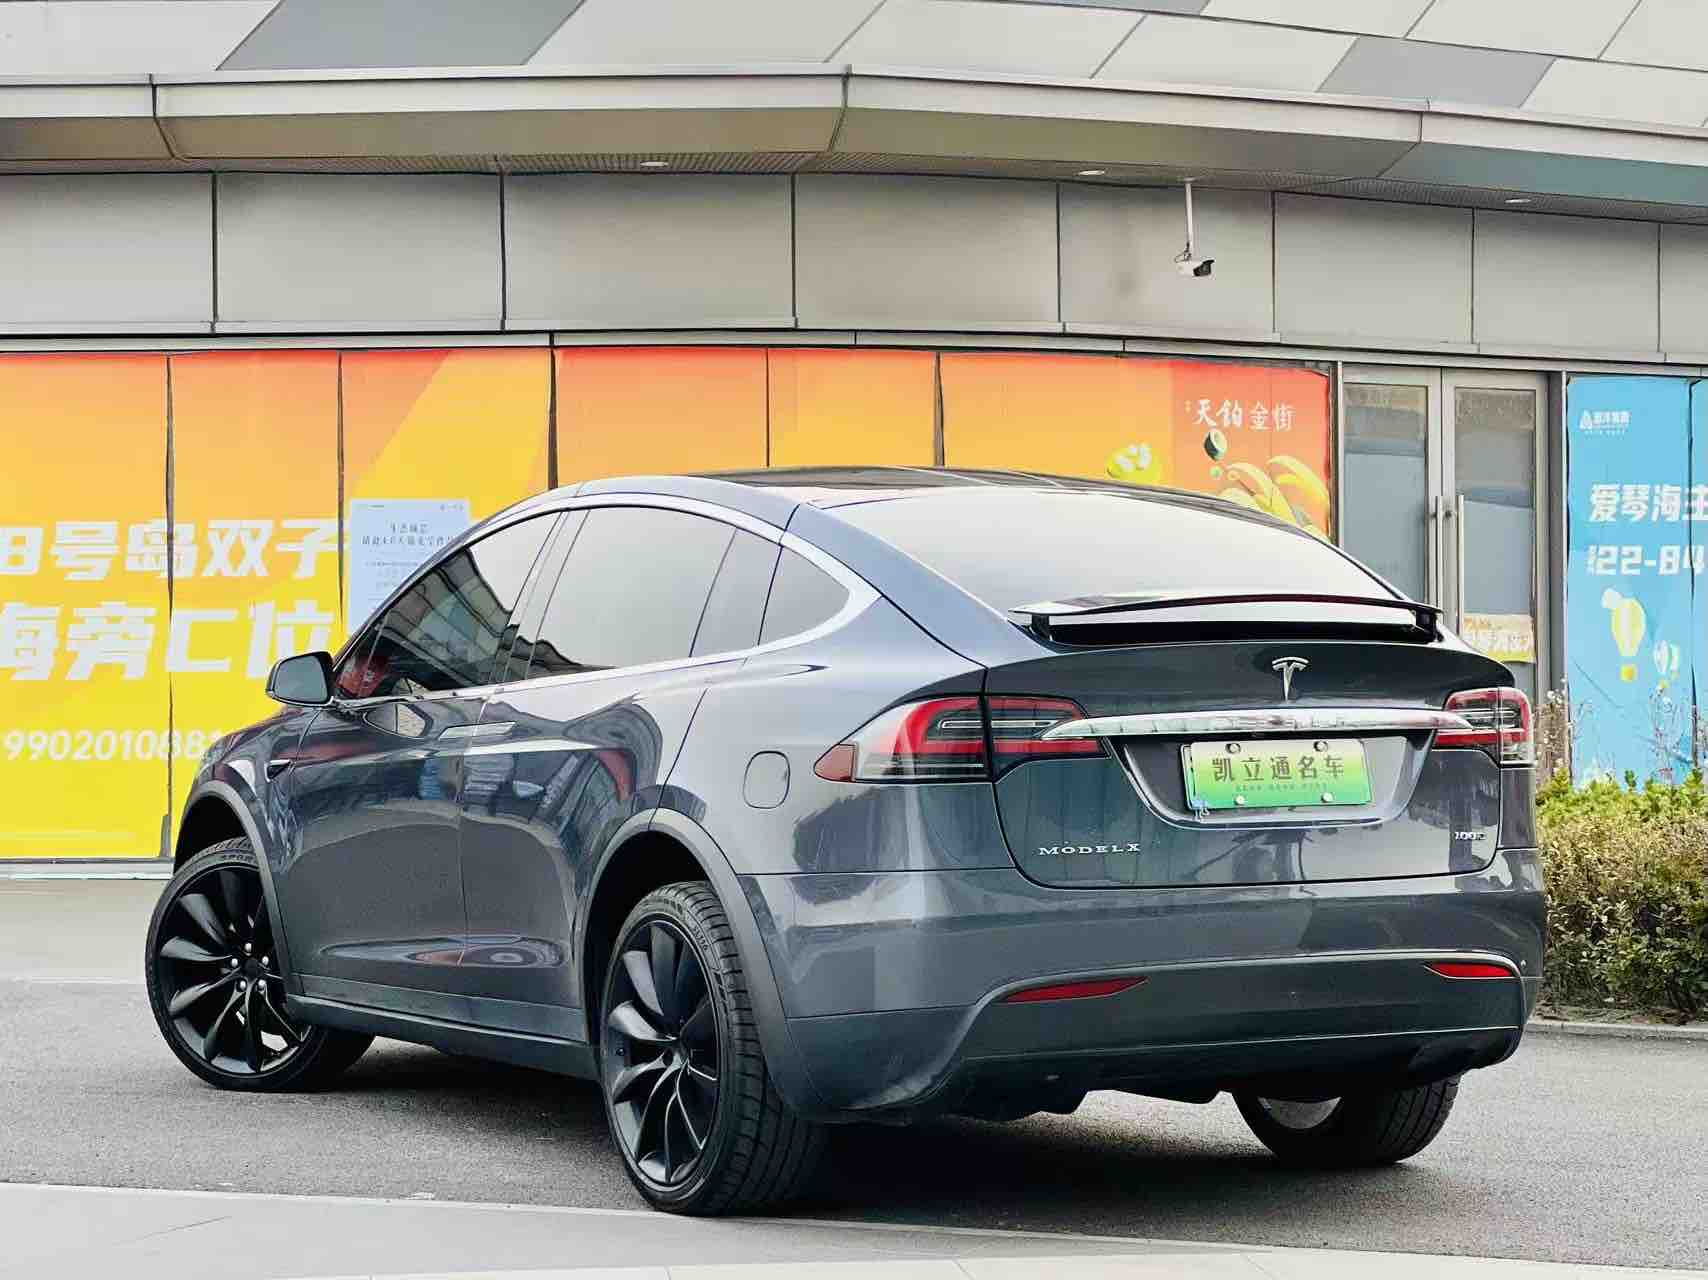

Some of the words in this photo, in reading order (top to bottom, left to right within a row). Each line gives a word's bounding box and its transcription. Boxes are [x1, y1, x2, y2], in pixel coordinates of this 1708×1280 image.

[1212, 755, 1344, 782] 凯立通名车
